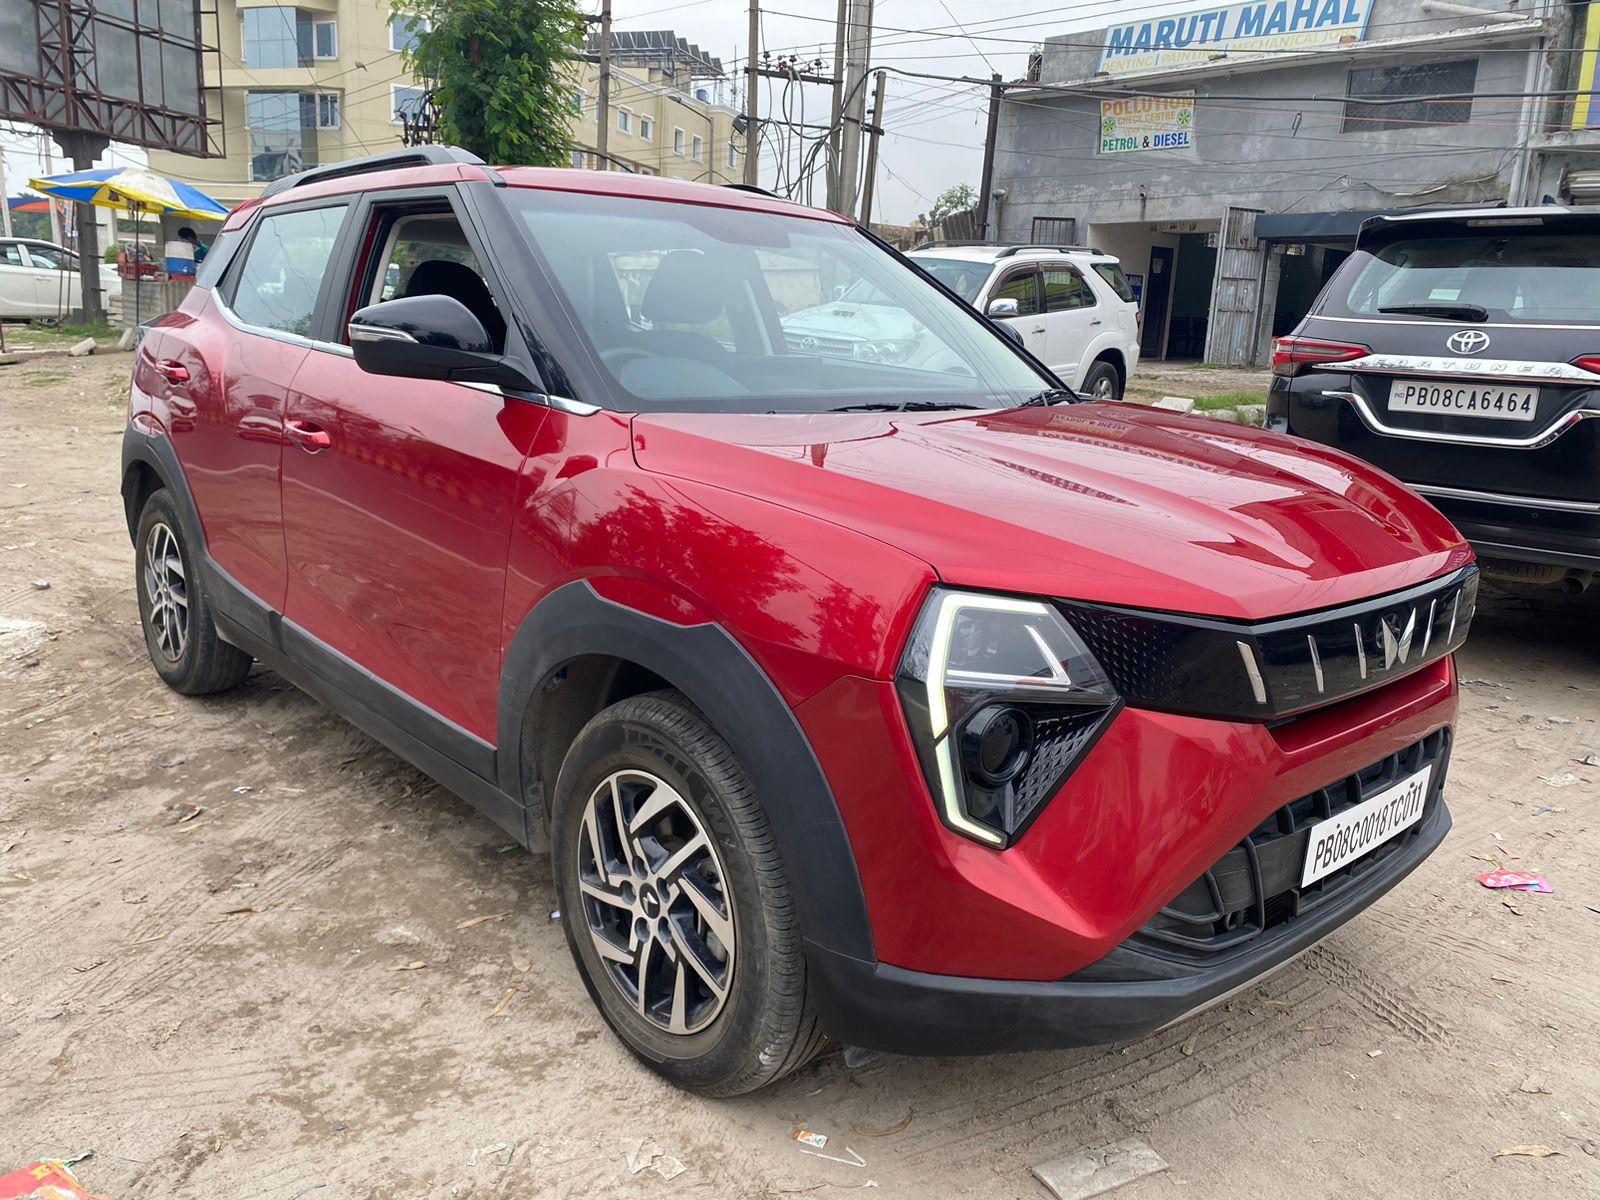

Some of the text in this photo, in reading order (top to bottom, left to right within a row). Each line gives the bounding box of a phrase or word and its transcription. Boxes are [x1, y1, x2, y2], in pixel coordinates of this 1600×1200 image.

[1106, 0, 1361, 58] MARUTI MAHAL
[1102, 56, 1153, 72] DENTING
[1231, 32, 1319, 51] MECHANICAL
[1102, 95, 1193, 117] POLLUTION
[1117, 111, 1176, 125] CHECK CENTRE
[1102, 132, 1189, 151] PETROL & DIESEL
[1404, 386, 1532, 413] PB08CA6464
[1313, 781, 1423, 874] PB08C0018TC011
